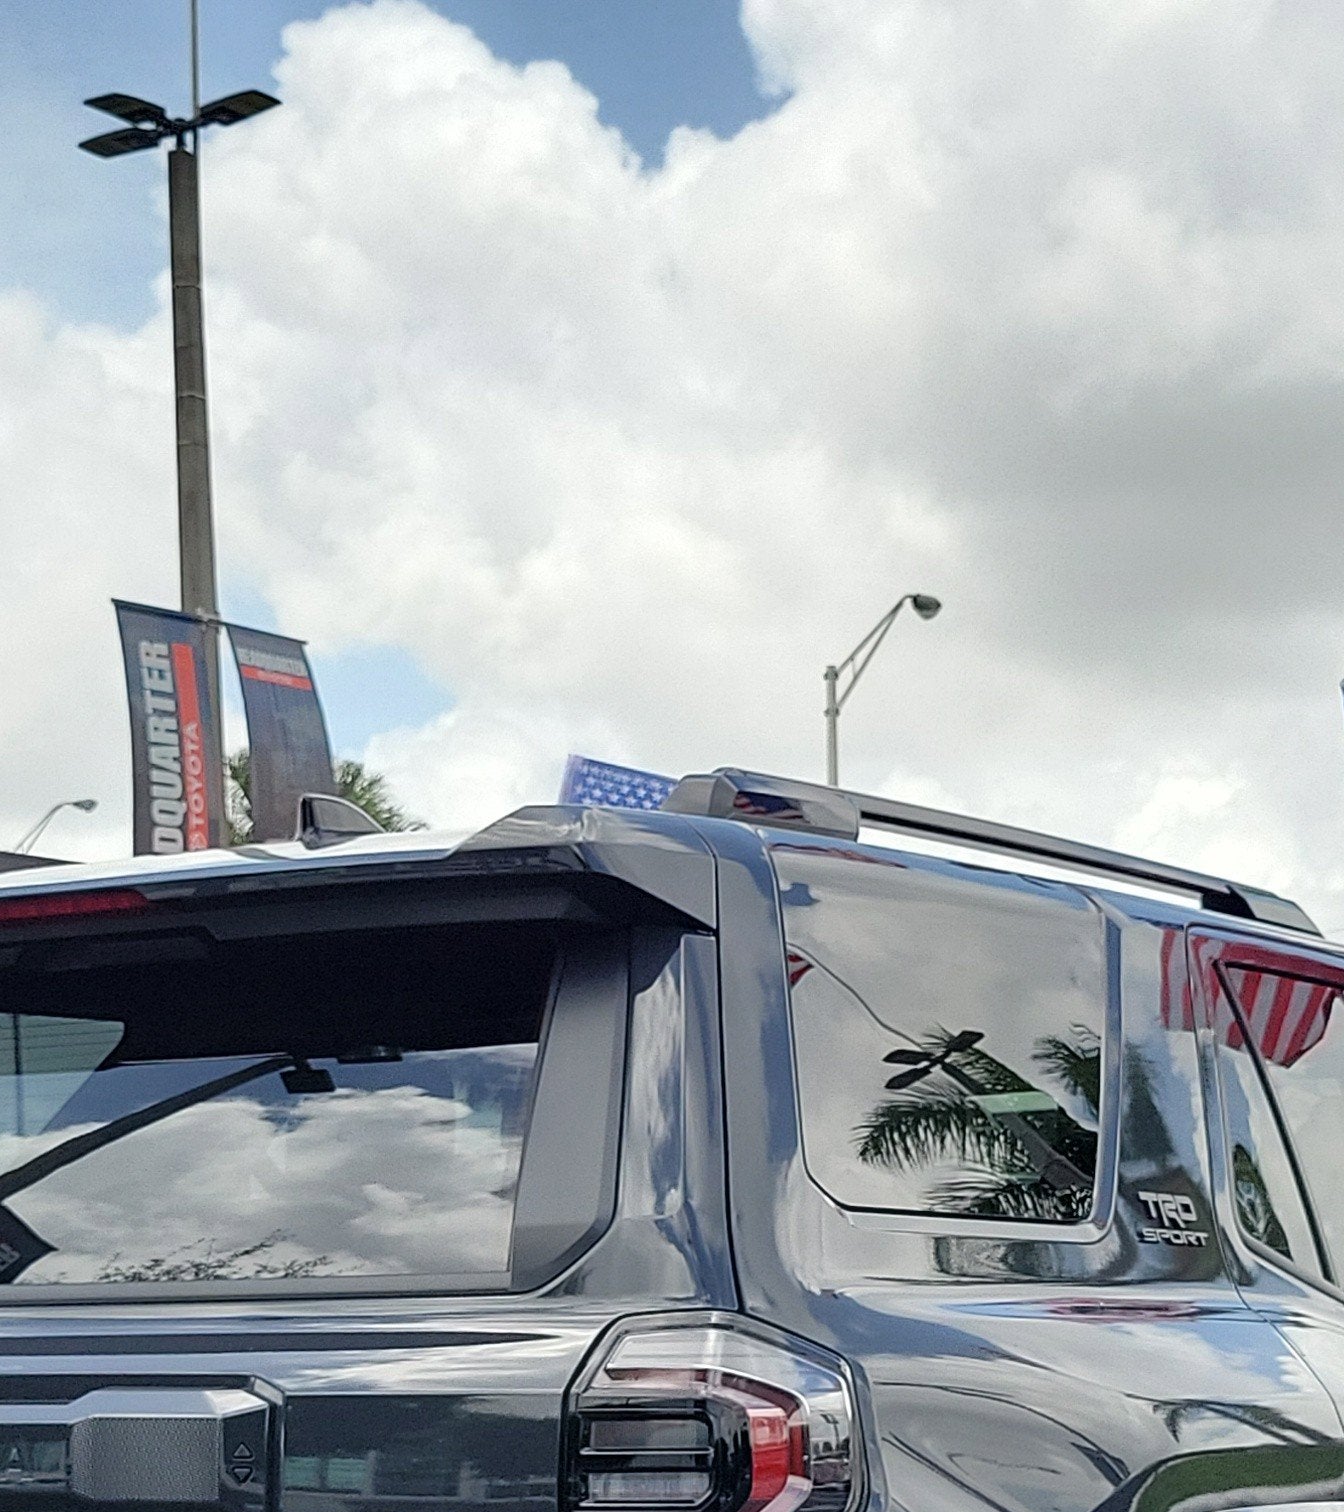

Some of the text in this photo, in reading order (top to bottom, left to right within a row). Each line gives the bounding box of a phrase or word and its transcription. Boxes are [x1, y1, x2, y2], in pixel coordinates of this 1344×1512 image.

[139, 640, 188, 853] DQUARTER
[182, 722, 205, 827] TOYOTA
[1137, 1190, 1198, 1229] TRD
[1141, 1228, 1209, 1247] SPORT
